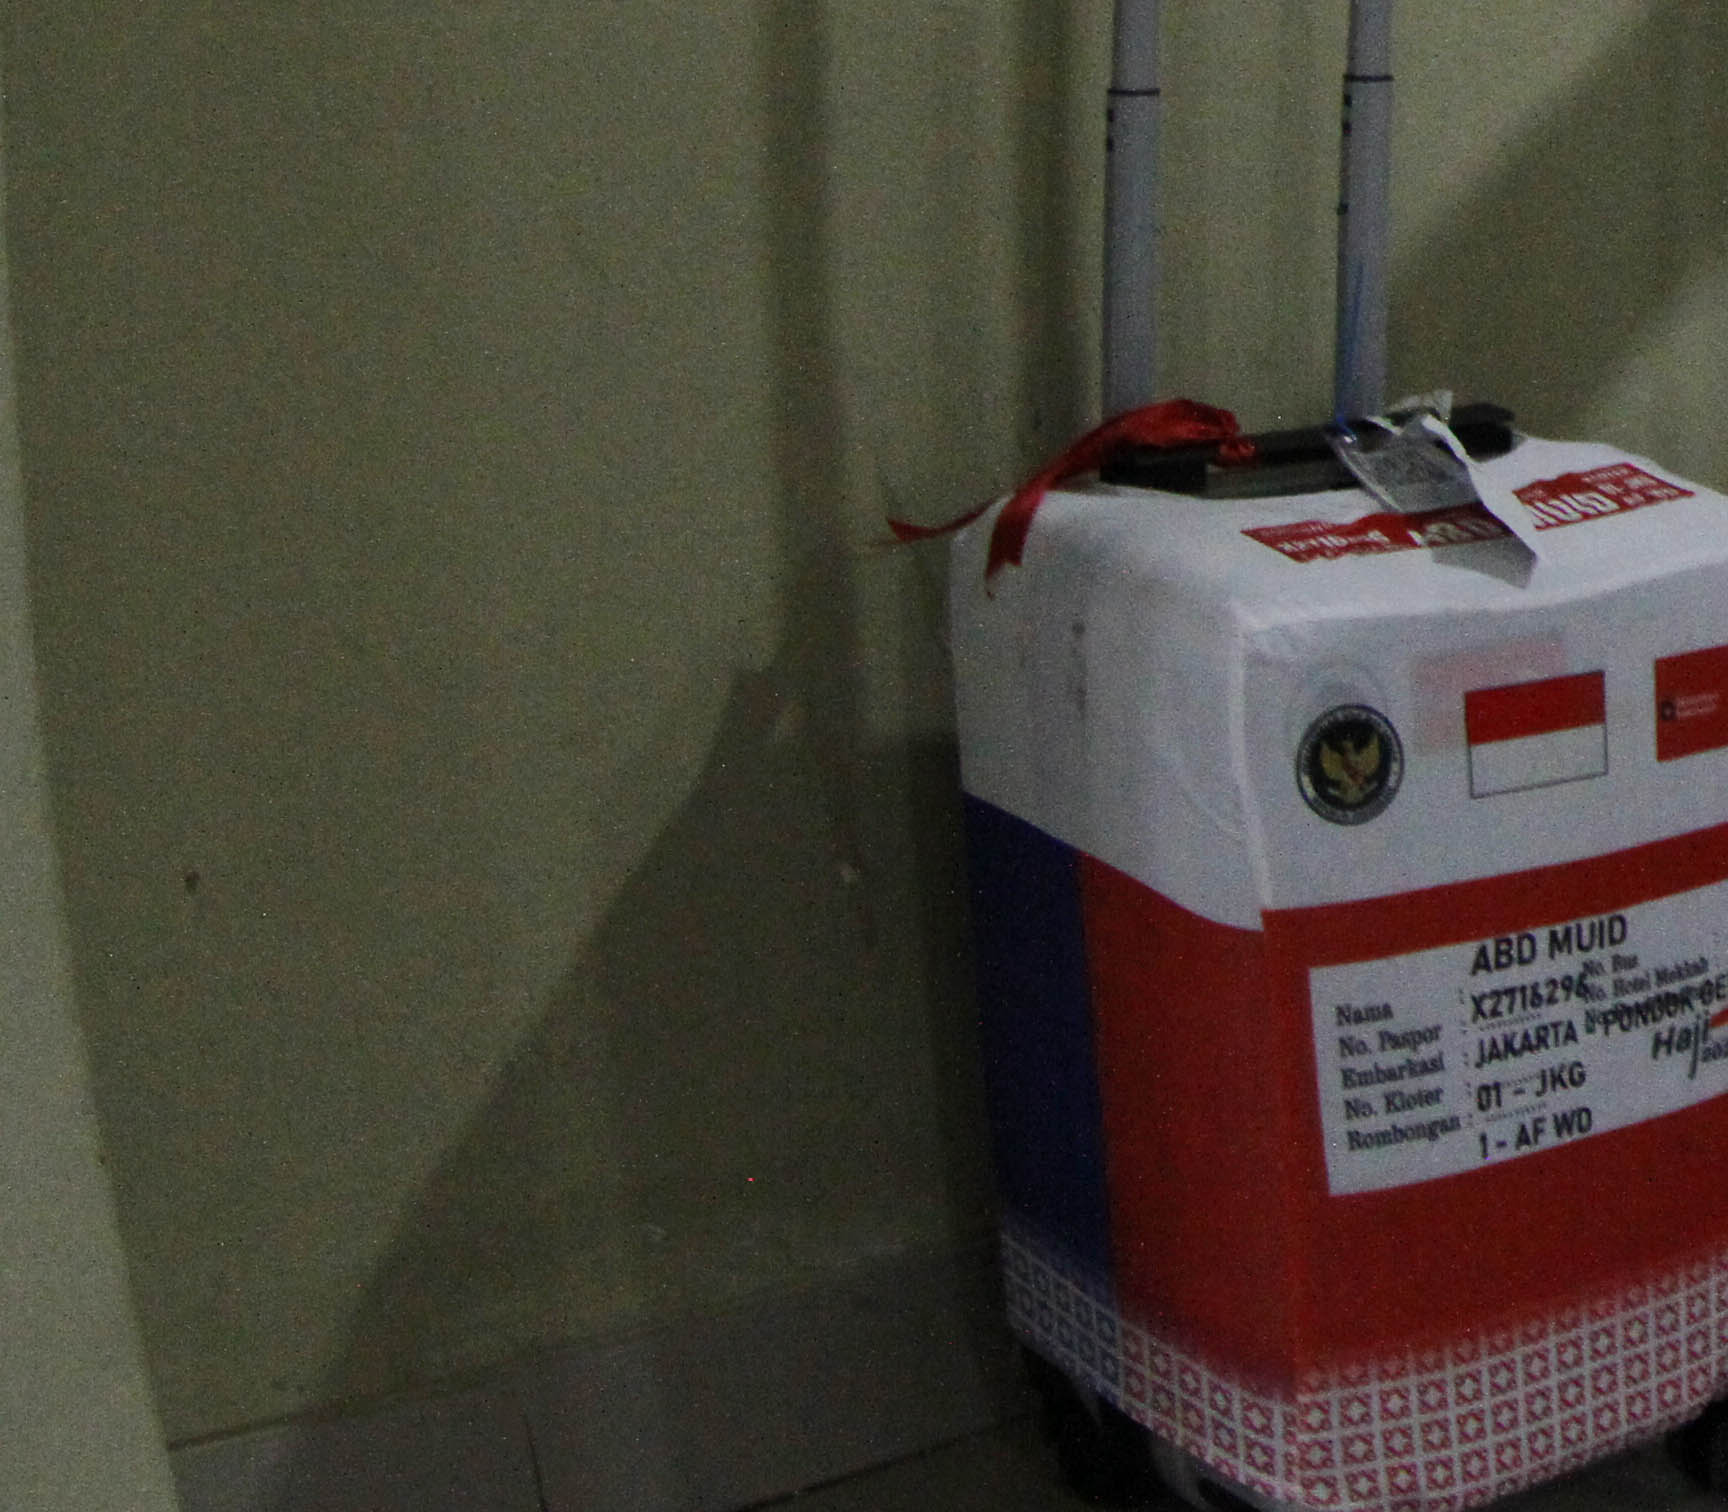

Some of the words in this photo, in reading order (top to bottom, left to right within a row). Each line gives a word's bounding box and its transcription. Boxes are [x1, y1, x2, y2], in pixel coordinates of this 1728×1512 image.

[1471, 934, 1536, 976] ABD
[1549, 914, 1627, 959] MUID
[1336, 1002, 1393, 1027] Nama
[1379, 1024, 1442, 1054] Paspor
[1475, 1020, 1578, 1069] JAKARTA
[1651, 1011, 1711, 1080] Haji
[1342, 1051, 1445, 1090] Embarkasi
[1477, 1082, 1502, 1112] 01
[1535, 1062, 1586, 1097] JKG
[1384, 1086, 1444, 1114] Kloter
[1348, 1114, 1460, 1152] Rombongan
[1516, 1116, 1546, 1149] AF
[1553, 1106, 1593, 1138] WD
